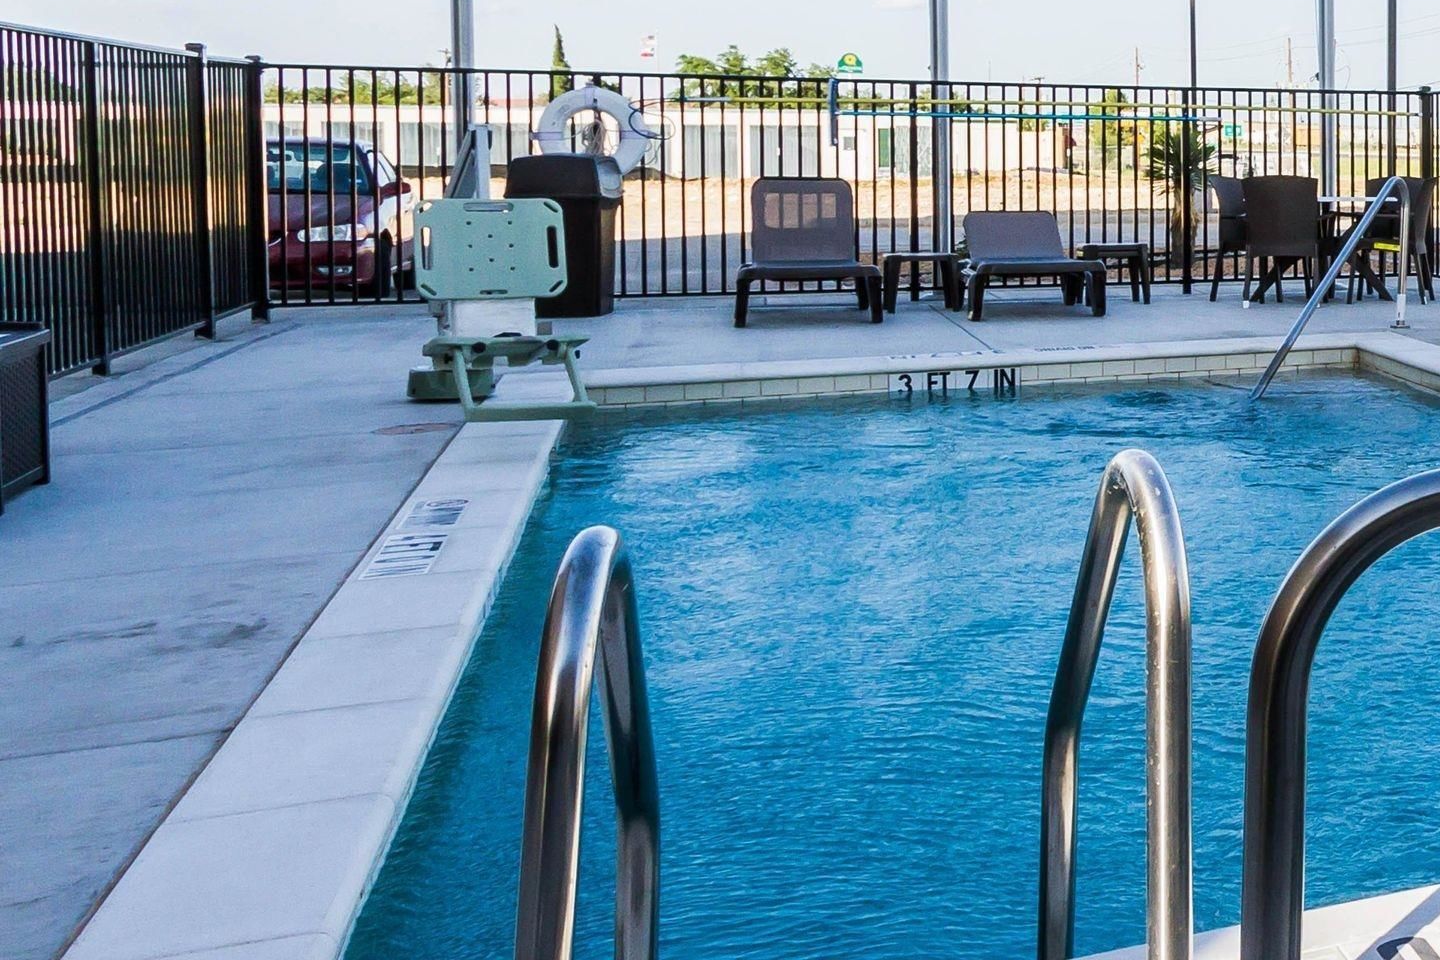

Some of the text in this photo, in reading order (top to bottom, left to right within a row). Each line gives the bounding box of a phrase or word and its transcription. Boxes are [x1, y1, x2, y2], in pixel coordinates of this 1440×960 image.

[898, 368, 1015, 392] 3 FT 7 IN
